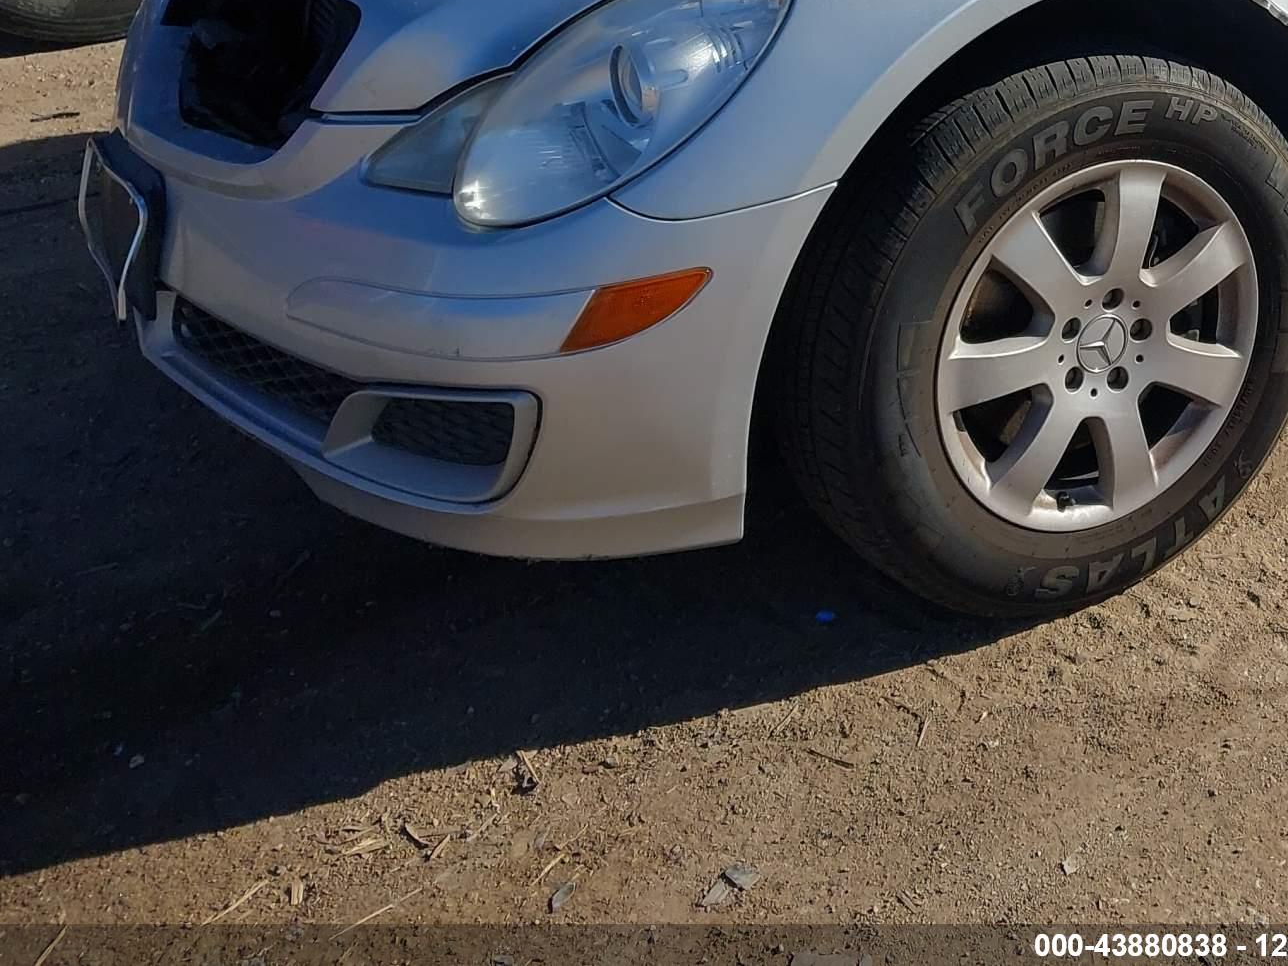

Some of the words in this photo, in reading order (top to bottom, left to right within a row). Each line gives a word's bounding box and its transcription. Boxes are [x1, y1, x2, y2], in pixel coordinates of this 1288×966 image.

[954, 99, 1155, 235] FORCE
[1164, 96, 1219, 125] HP
[1034, 475, 1226, 599] ATLAS
